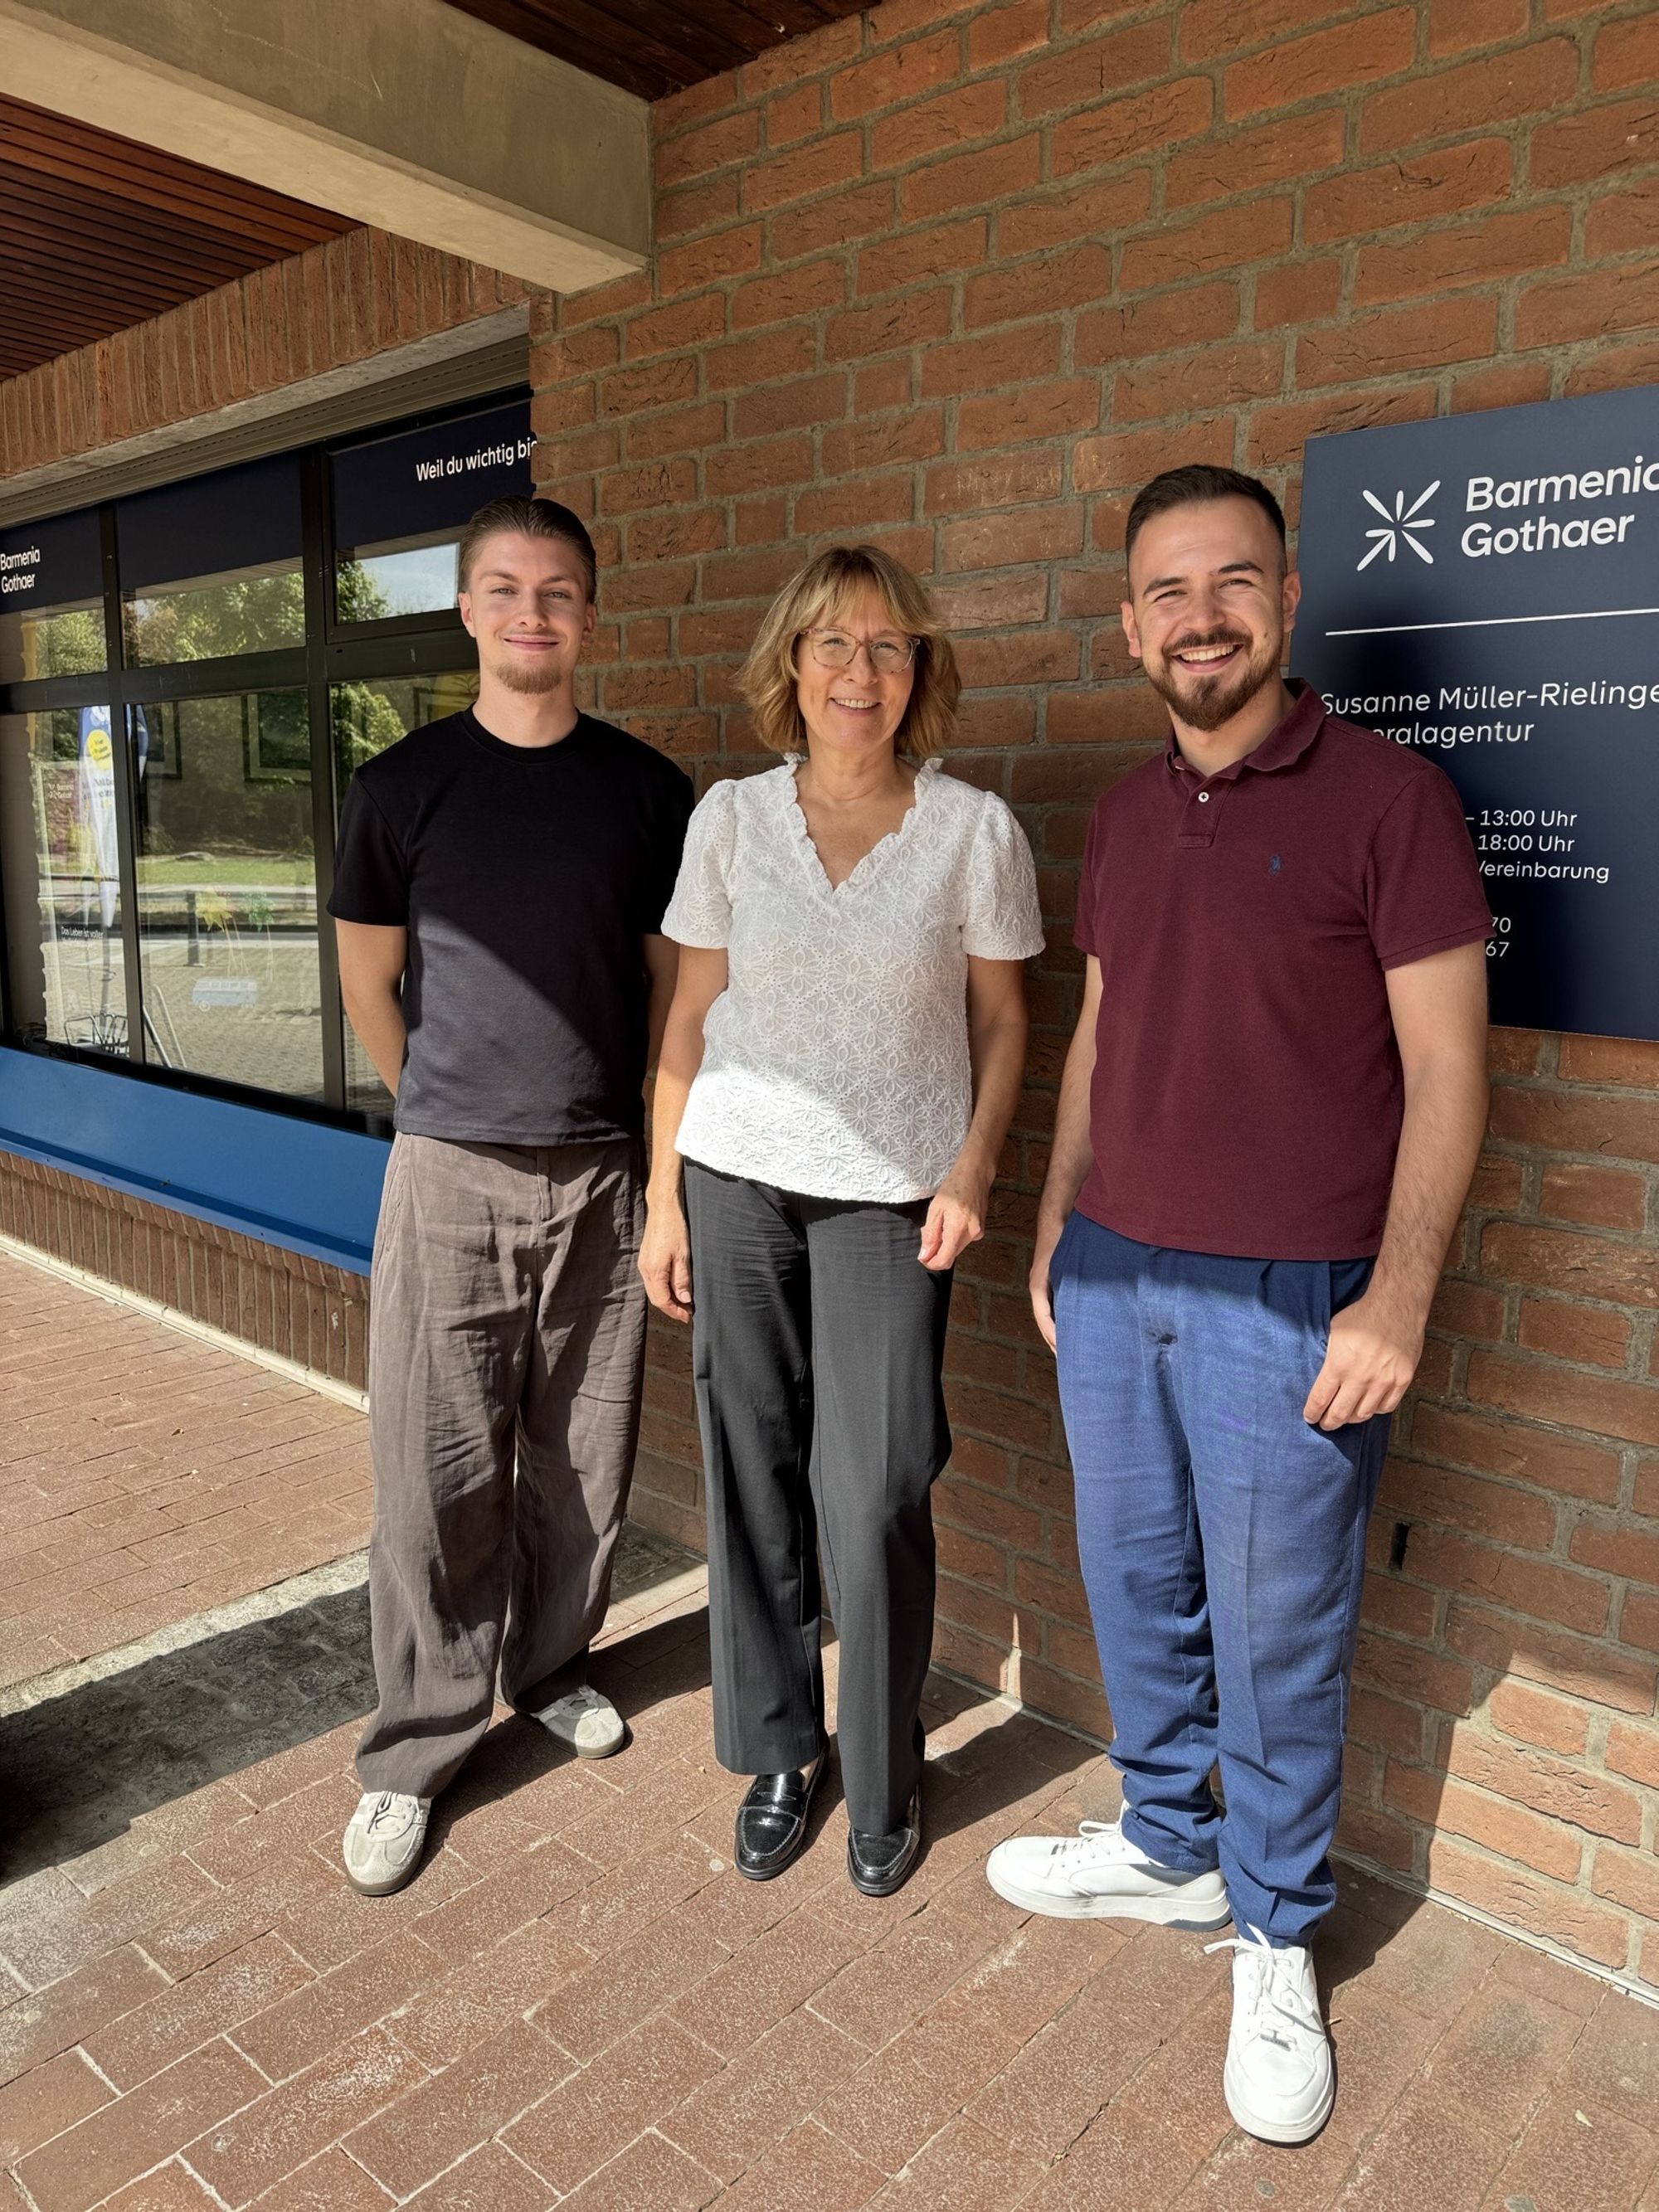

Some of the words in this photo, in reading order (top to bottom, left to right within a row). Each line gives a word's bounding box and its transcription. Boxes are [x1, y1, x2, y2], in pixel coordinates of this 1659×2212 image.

[416, 459, 444, 481] Weil
[446, 456, 463, 474] du
[466, 443, 514, 470] wichtig
[1461, 514, 1635, 557] Gothaer
[0, 545, 41, 571] Barmenia
[2, 573, 35, 593] Gothaer
[1321, 693, 1431, 714] Susanne
[1480, 809, 1535, 826] 13:00
[1540, 809, 1578, 827] Uhr
[1477, 834, 1533, 851] 18:00
[1538, 835, 1575, 852] Uhr
[1485, 941, 1510, 957] 67
